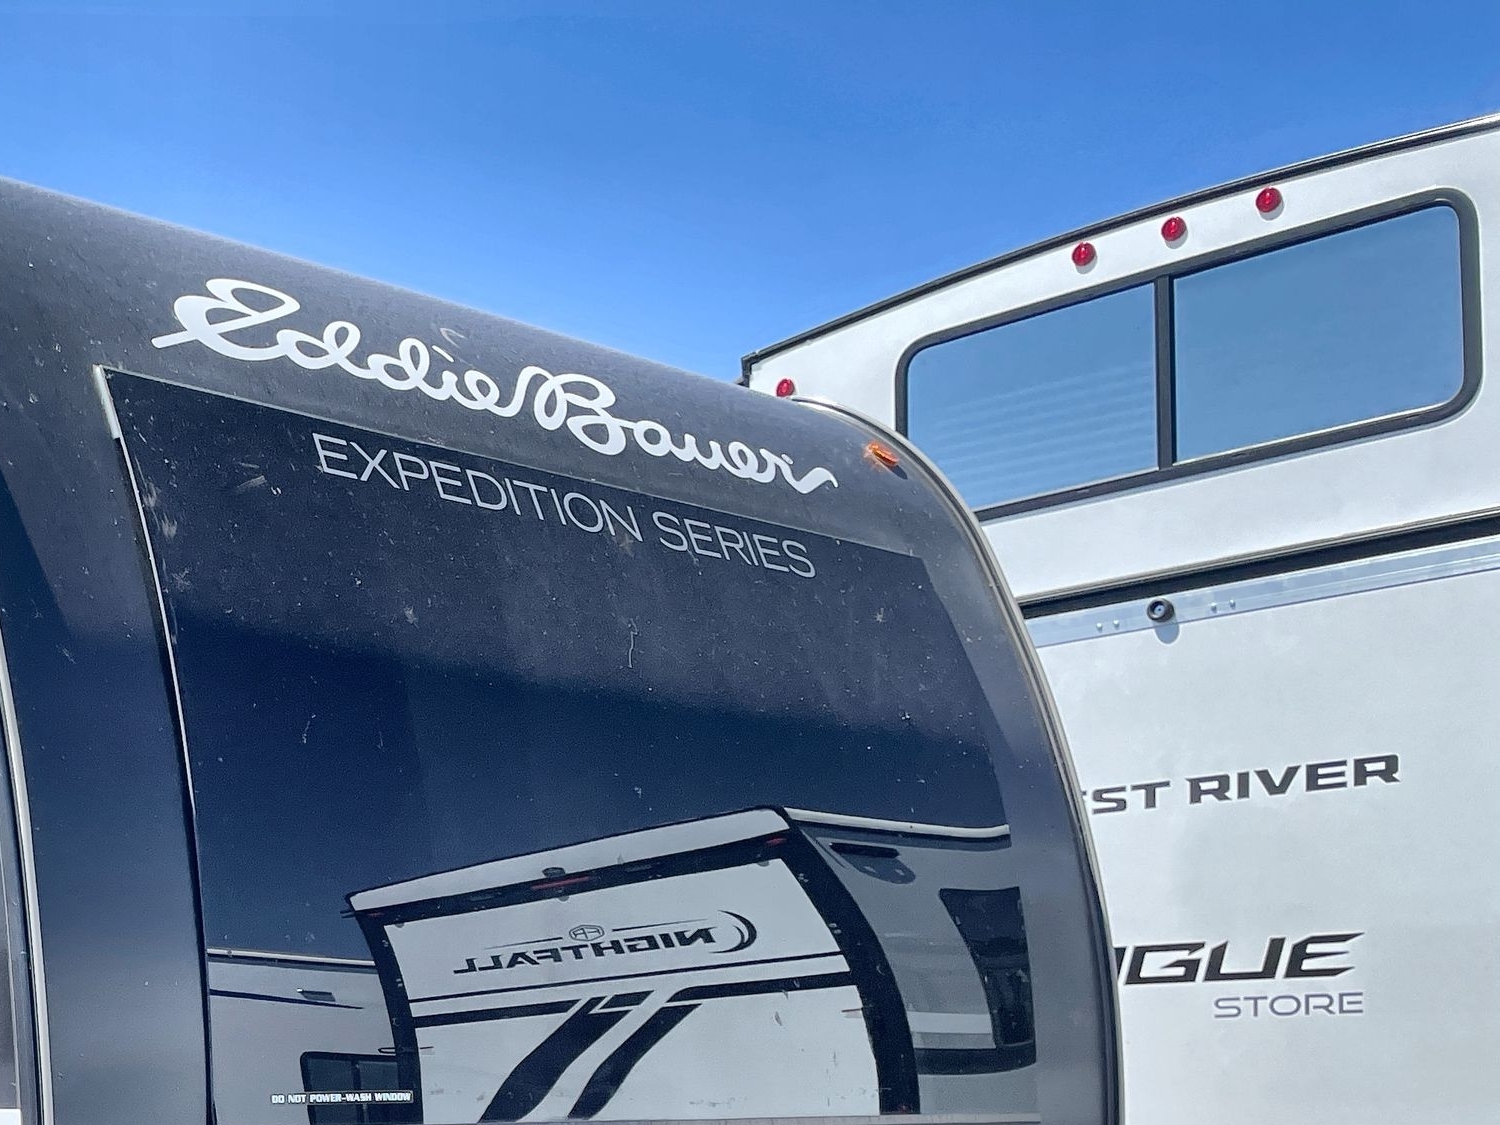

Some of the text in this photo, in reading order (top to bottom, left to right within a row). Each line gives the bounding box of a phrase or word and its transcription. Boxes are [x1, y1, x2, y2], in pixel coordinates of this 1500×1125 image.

[151, 278, 839, 493] Eddie Bauer
[312, 432, 816, 578] EXPEDITION SERIES
[1080, 754, 1401, 815] ST RIVER
[1214, 992, 1364, 1019] STORE
[272, 1092, 411, 1103] DO NOT POWER-WASH WINDOW
